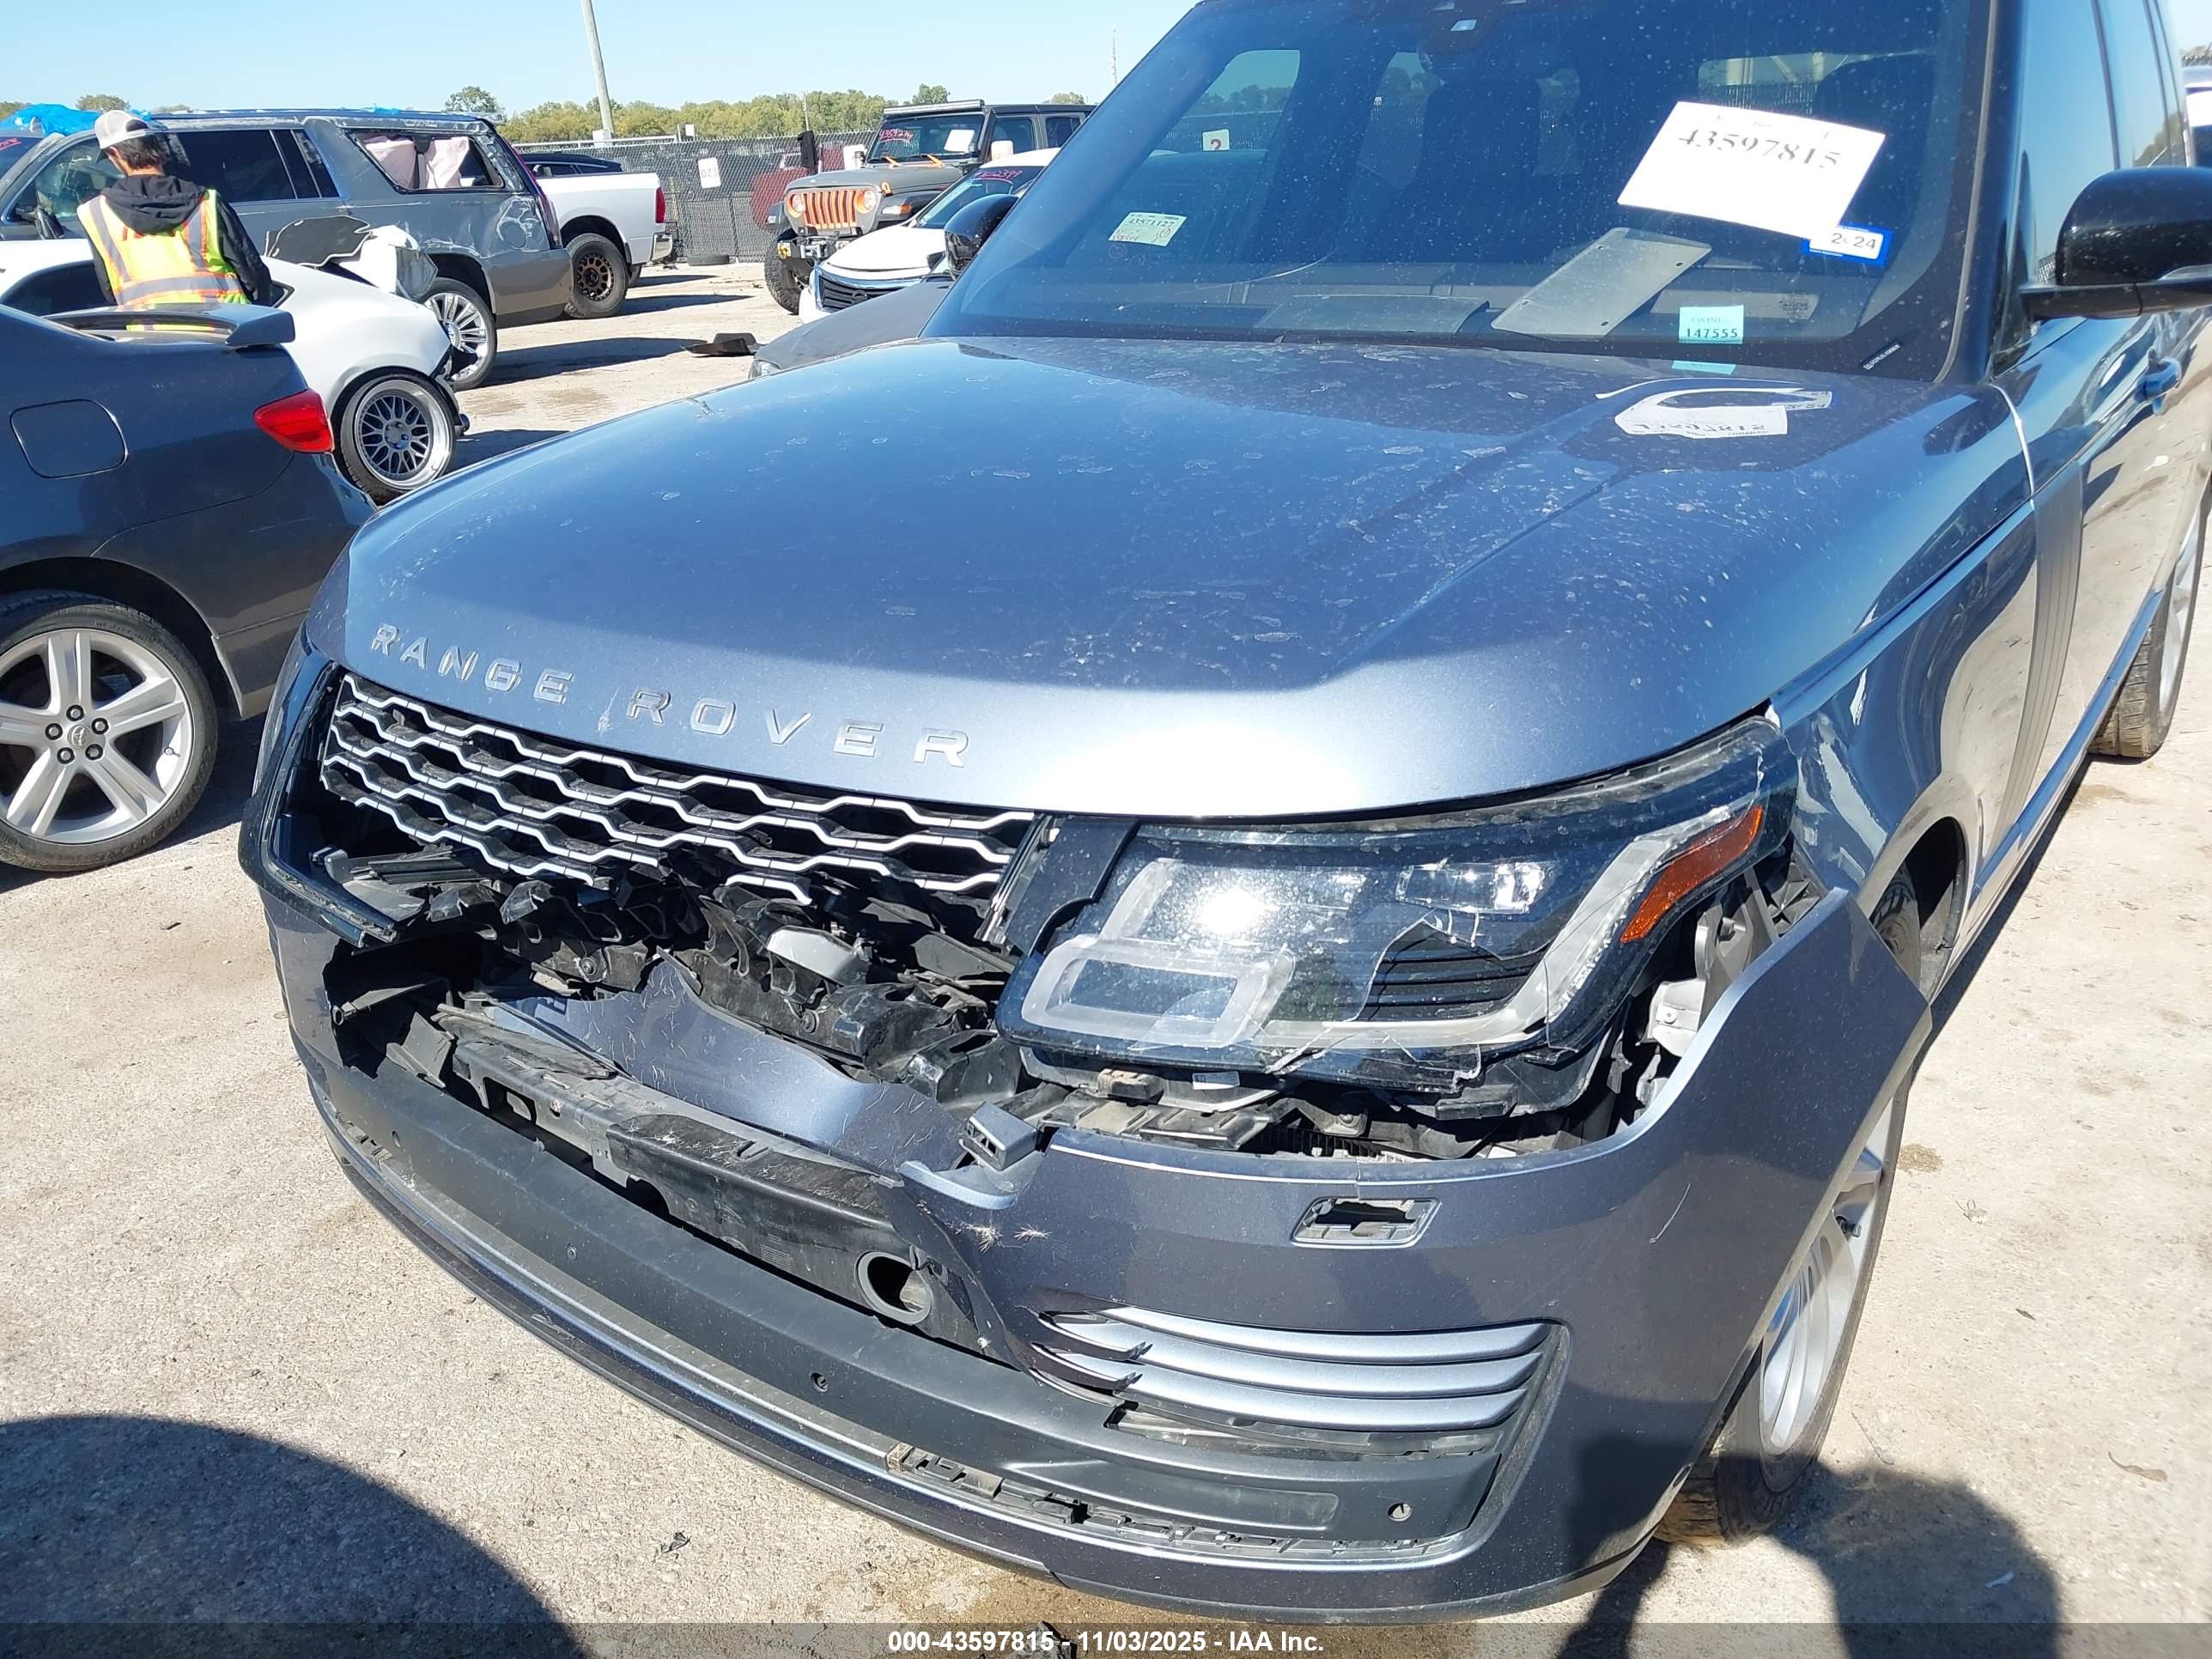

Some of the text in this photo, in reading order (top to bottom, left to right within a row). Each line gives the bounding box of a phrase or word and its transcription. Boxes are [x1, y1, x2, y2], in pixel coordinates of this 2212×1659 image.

[1679, 128, 1842, 168] 43597815
[1852, 235, 1876, 249] 24
[1686, 328, 1738, 338] 147555
[370, 623, 969, 768] RANGE ROVER
